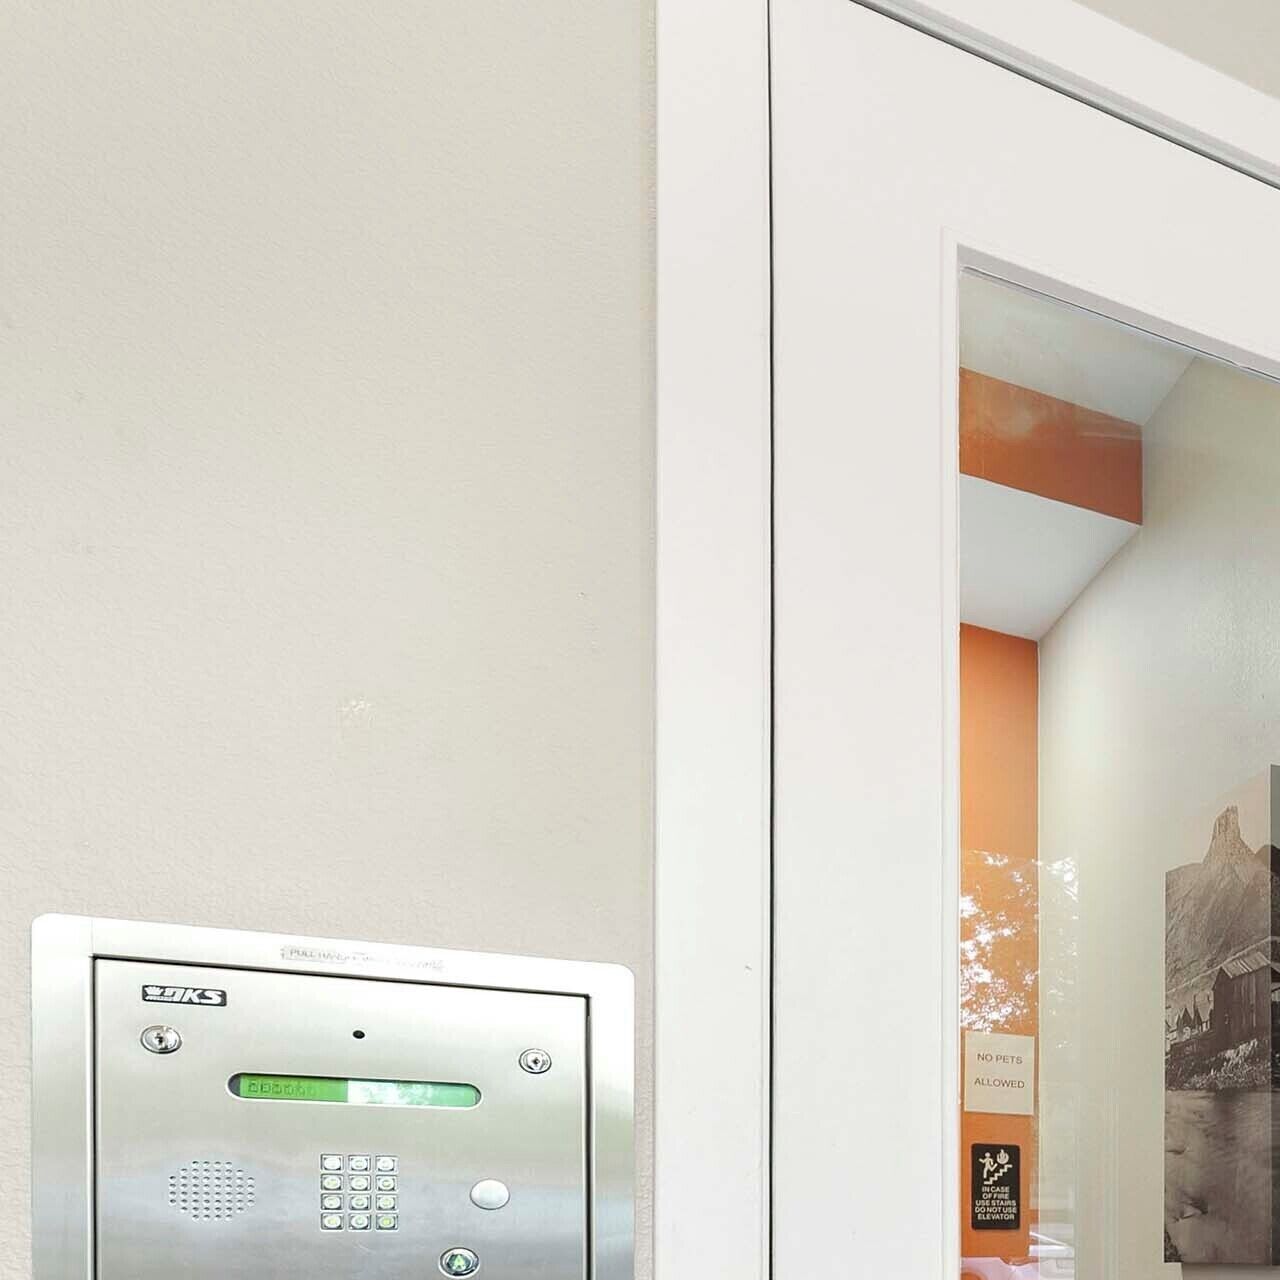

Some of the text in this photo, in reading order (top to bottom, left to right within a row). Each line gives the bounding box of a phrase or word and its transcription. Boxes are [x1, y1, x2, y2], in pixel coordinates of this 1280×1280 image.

[976, 1053, 1023, 1065] NO PETS
[974, 1077, 1025, 1089] ALLOWED
[452, 1254, 467, 1271] A
